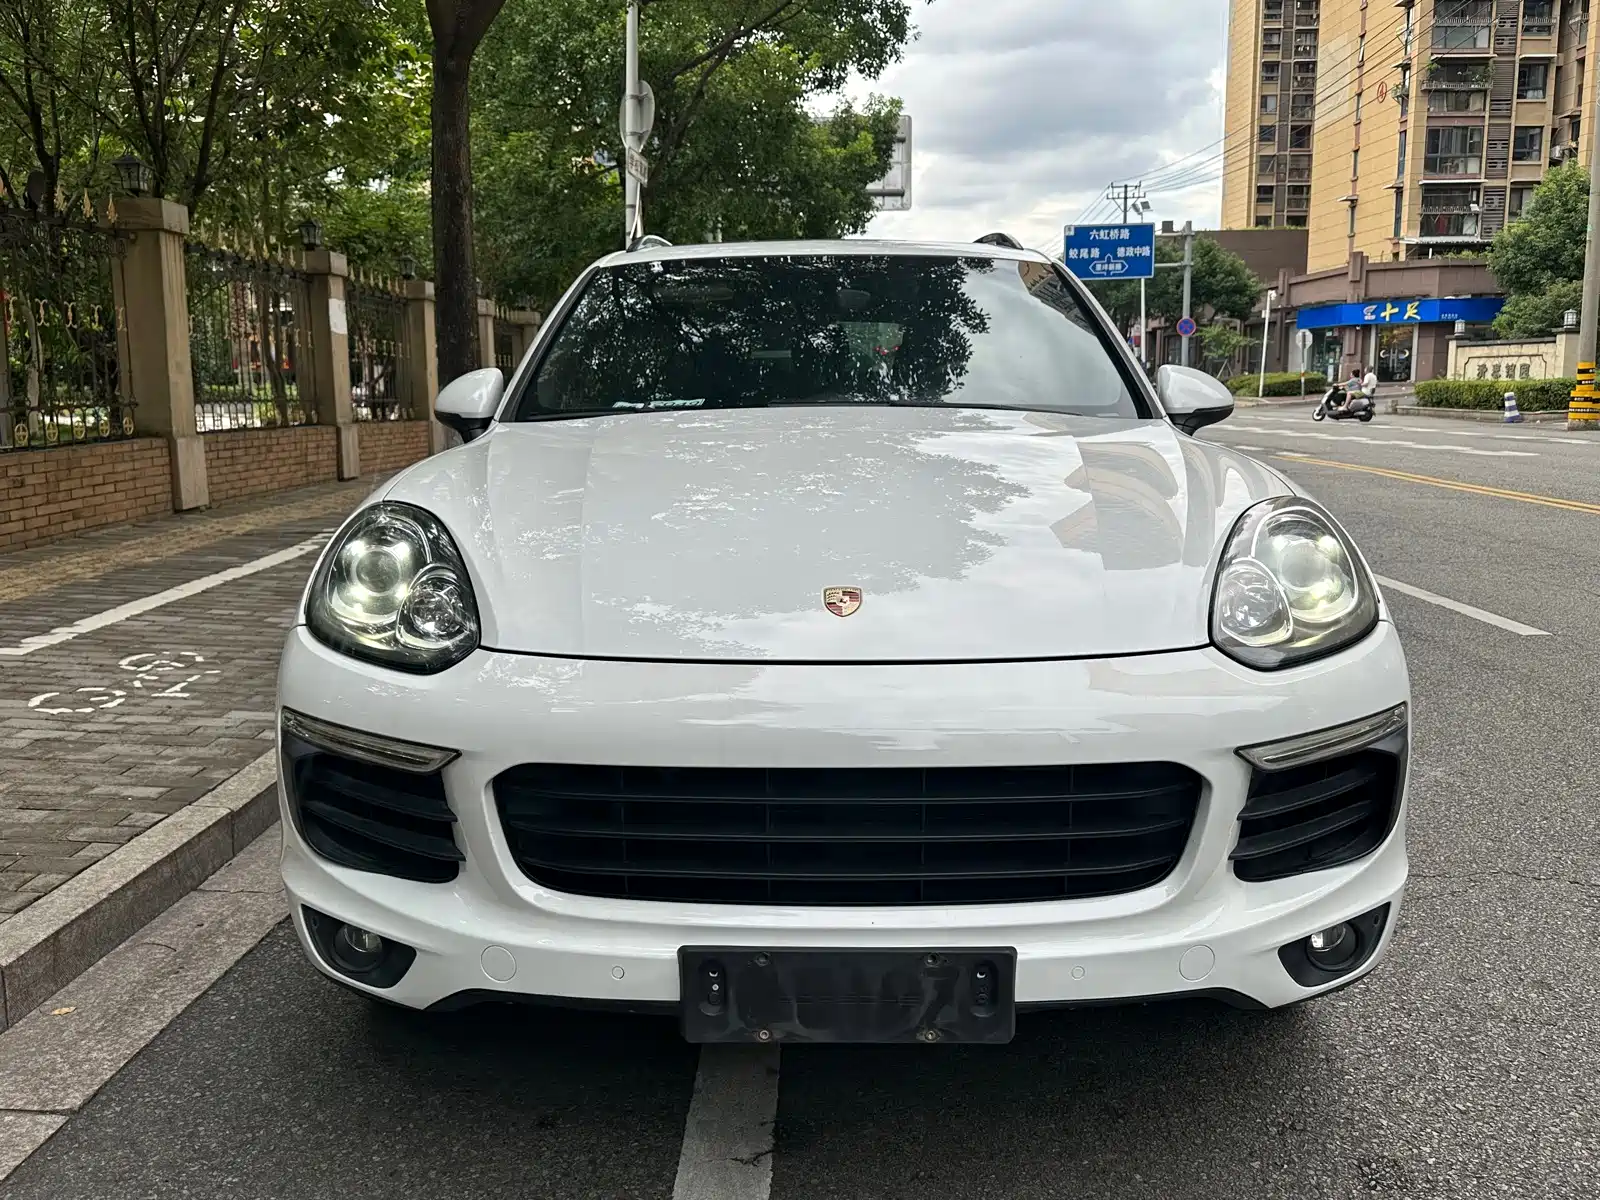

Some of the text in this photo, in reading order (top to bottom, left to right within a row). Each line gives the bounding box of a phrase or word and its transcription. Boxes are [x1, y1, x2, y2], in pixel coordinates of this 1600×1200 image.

[1089, 228, 1130, 240] 六虹桥路
[1117, 245, 1151, 258] 德政中路
[1380, 302, 1421, 321] 十足
